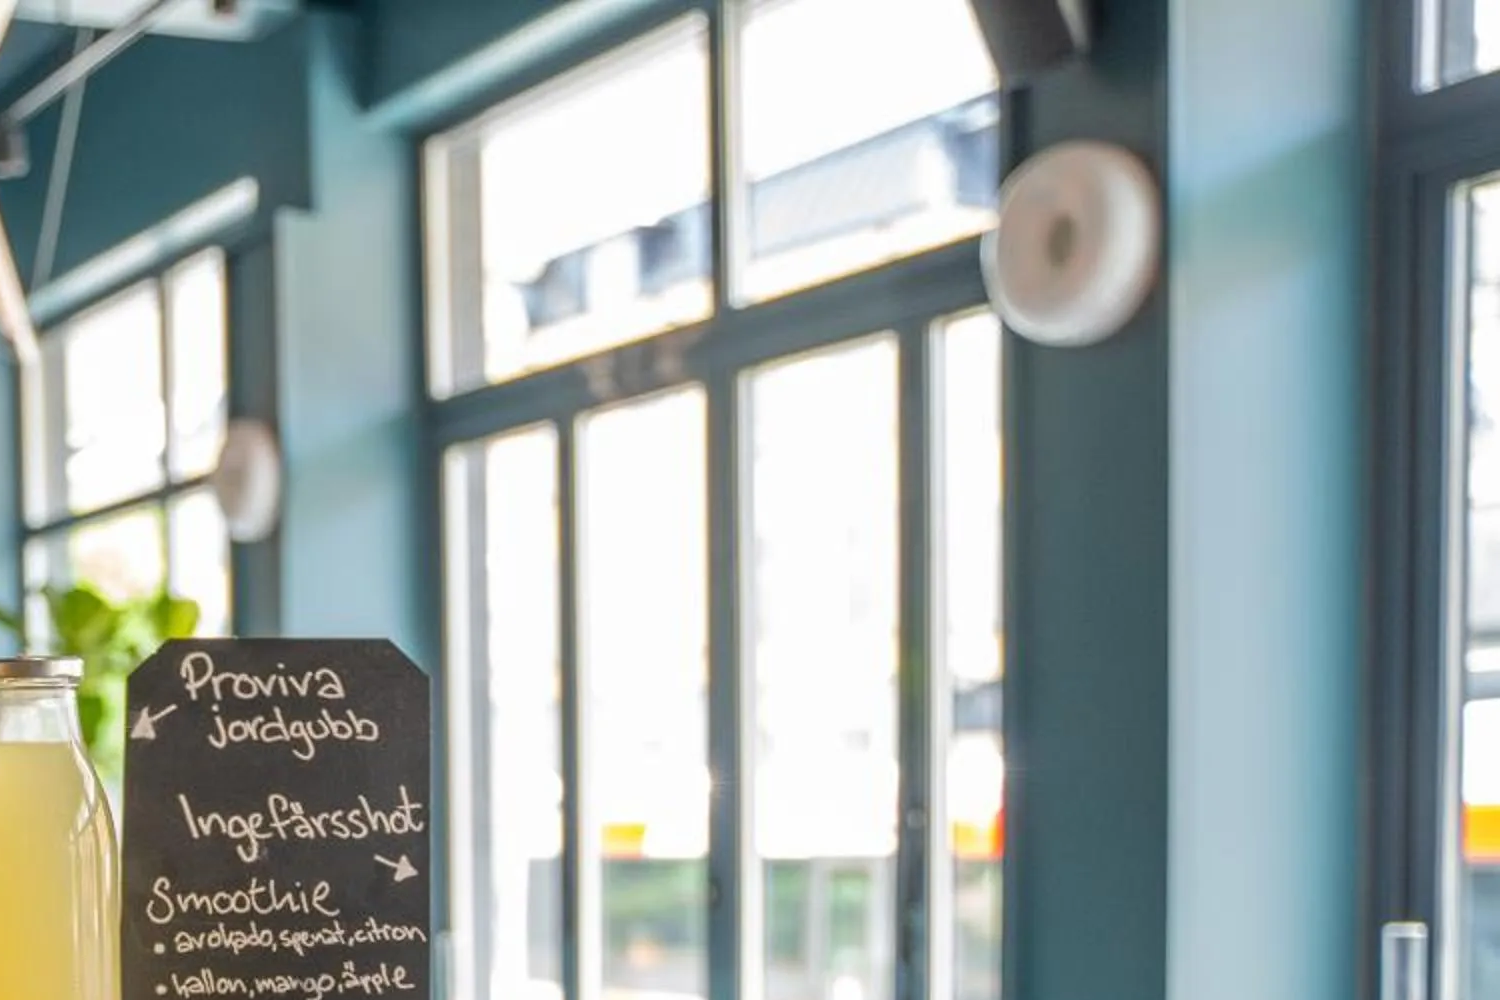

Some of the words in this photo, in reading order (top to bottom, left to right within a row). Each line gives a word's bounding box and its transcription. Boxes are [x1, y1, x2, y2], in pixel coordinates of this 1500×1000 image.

[180, 652, 345, 700] Proviva
[208, 704, 379, 760] jordgubb
[178, 785, 424, 862] Ingefärsshot
[146, 877, 340, 924] Smoothie
